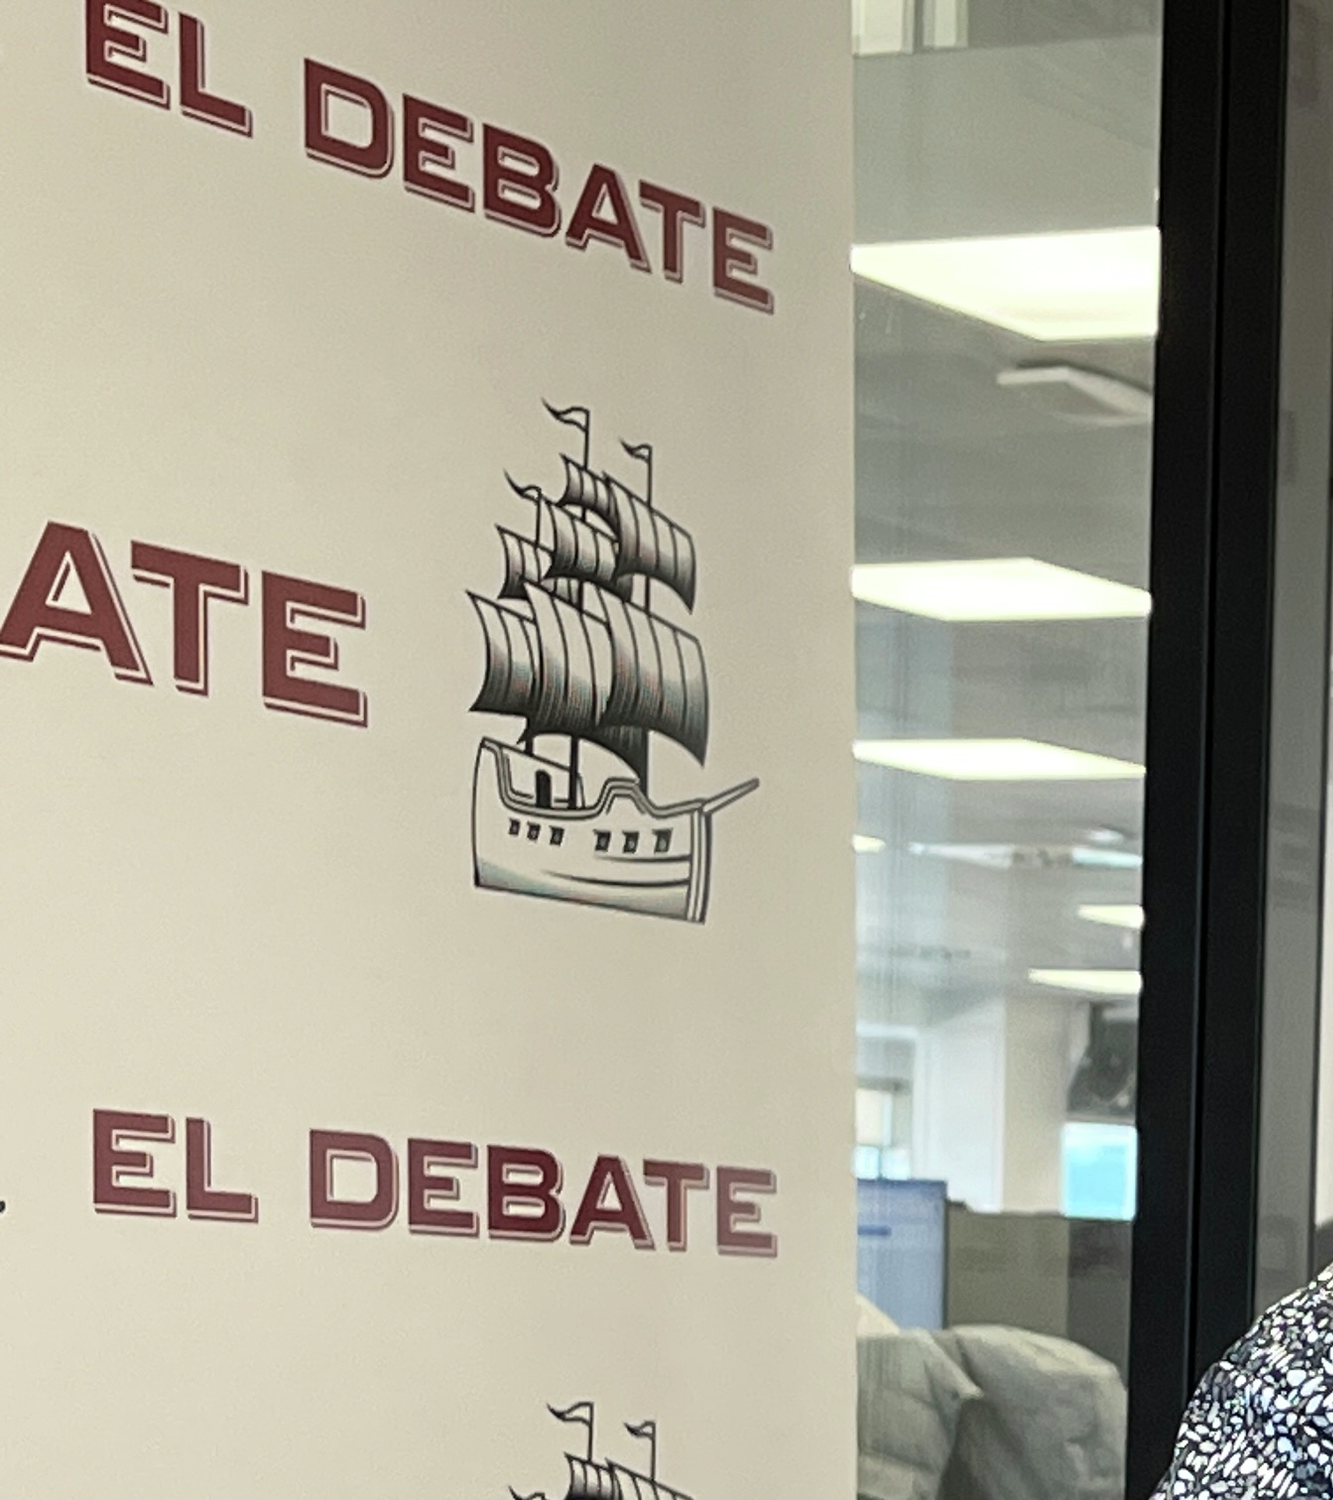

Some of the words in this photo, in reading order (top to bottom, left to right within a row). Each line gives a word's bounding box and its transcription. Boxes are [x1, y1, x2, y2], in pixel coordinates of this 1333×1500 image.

[86, 0, 253, 137] EL
[303, 58, 775, 313] DEBATE
[0, 521, 368, 728] ATE
[92, 1108, 258, 1224] EL
[309, 1128, 779, 1258] DEBATE
